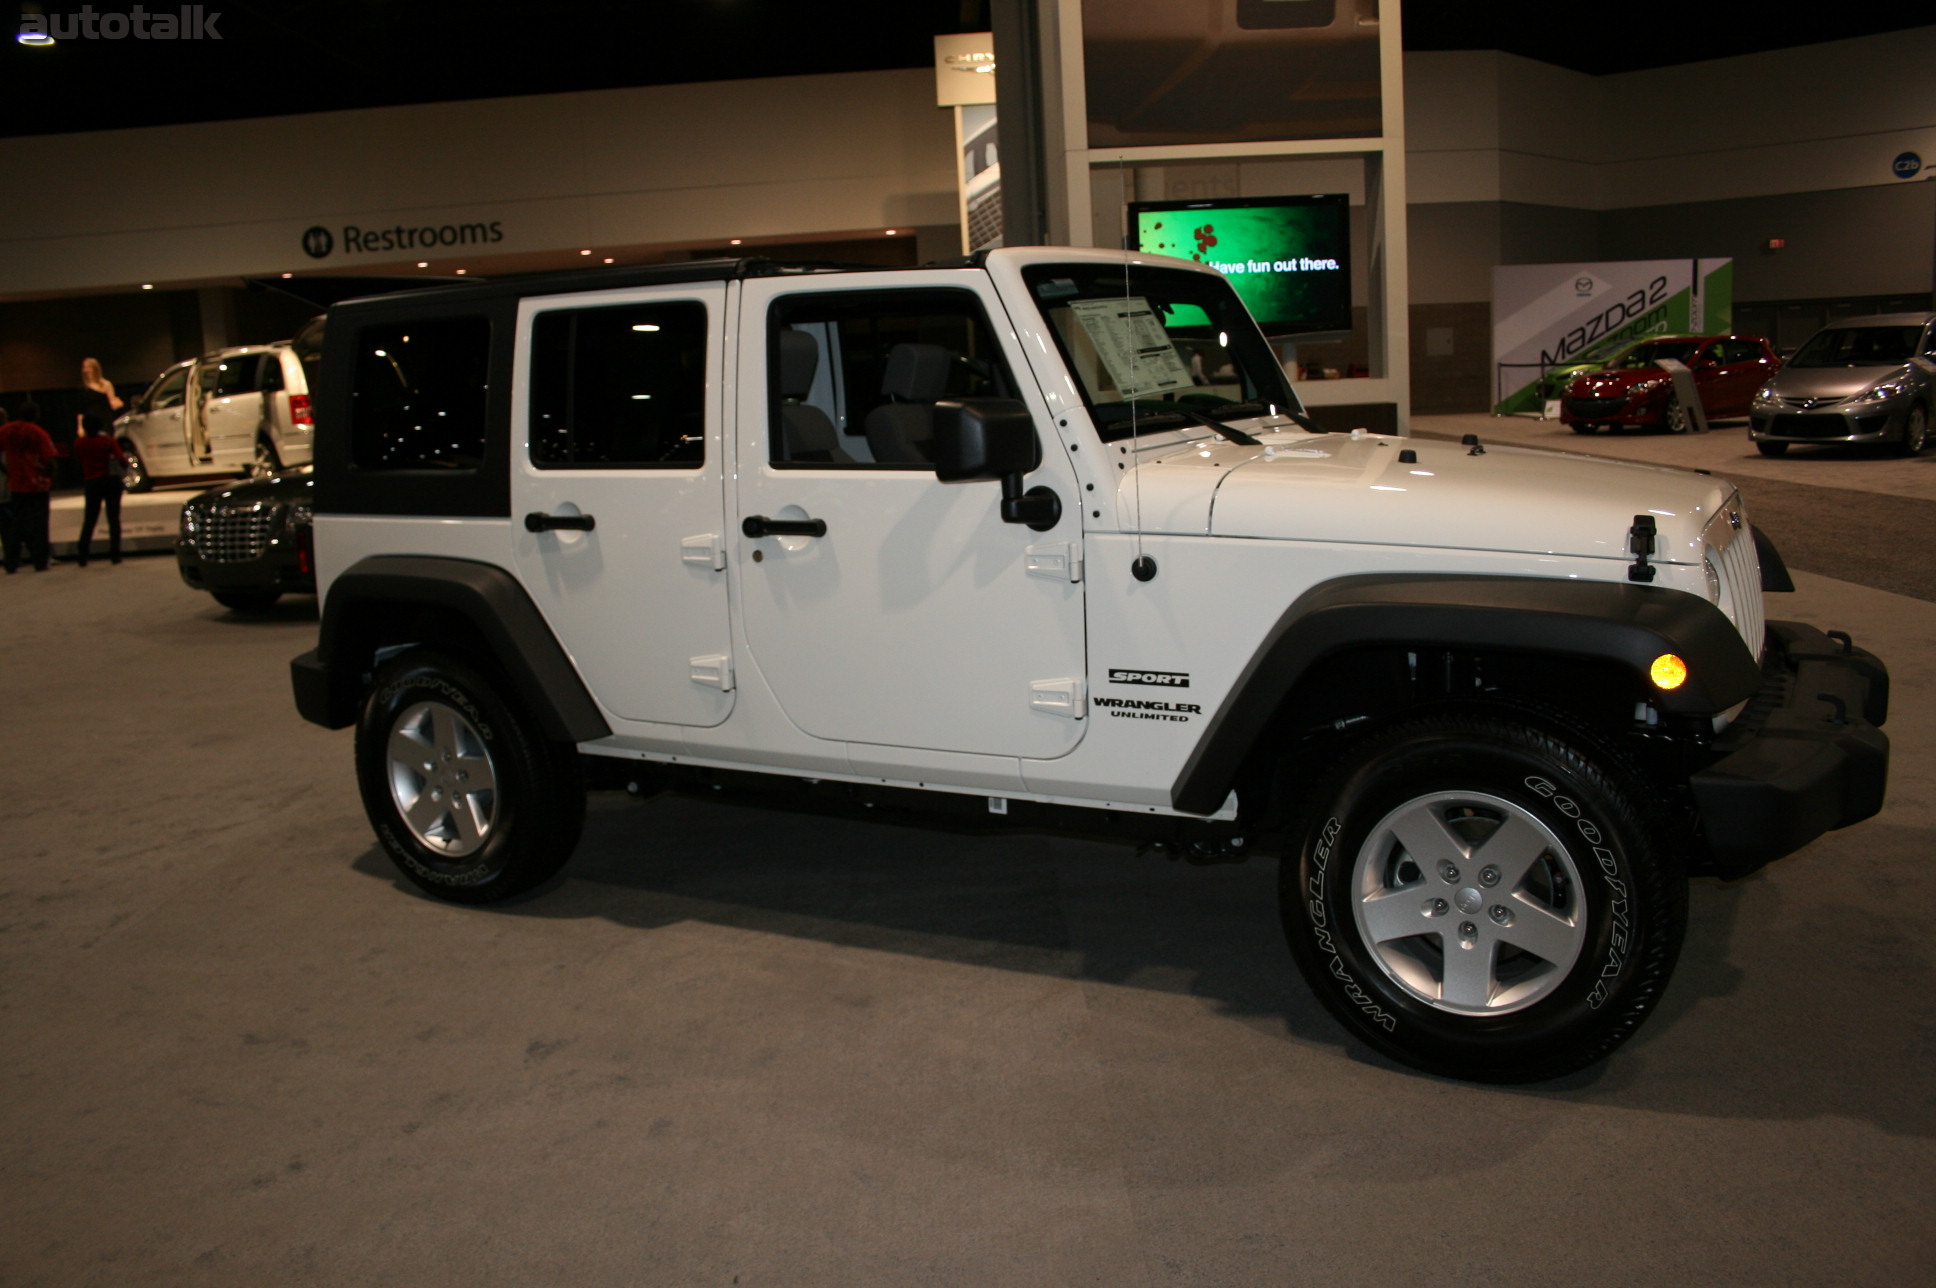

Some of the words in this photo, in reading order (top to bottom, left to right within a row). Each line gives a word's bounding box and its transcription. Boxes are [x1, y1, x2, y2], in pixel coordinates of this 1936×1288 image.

[1171, 175, 1237, 197] ents
[343, 221, 503, 254] Restrooms
[1208, 260, 1245, 275] Have
[1247, 259, 1271, 273] fun
[1273, 258, 1298, 272] out
[1299, 256, 1339, 271] there.
[1109, 670, 1189, 686] SPORT
[1093, 697, 1202, 715] WRANGLER
[1111, 711, 1189, 723] UNLIMITED
[1524, 776, 1628, 1010] GOODYEAR
[1309, 816, 1397, 1032] WRANGLER
